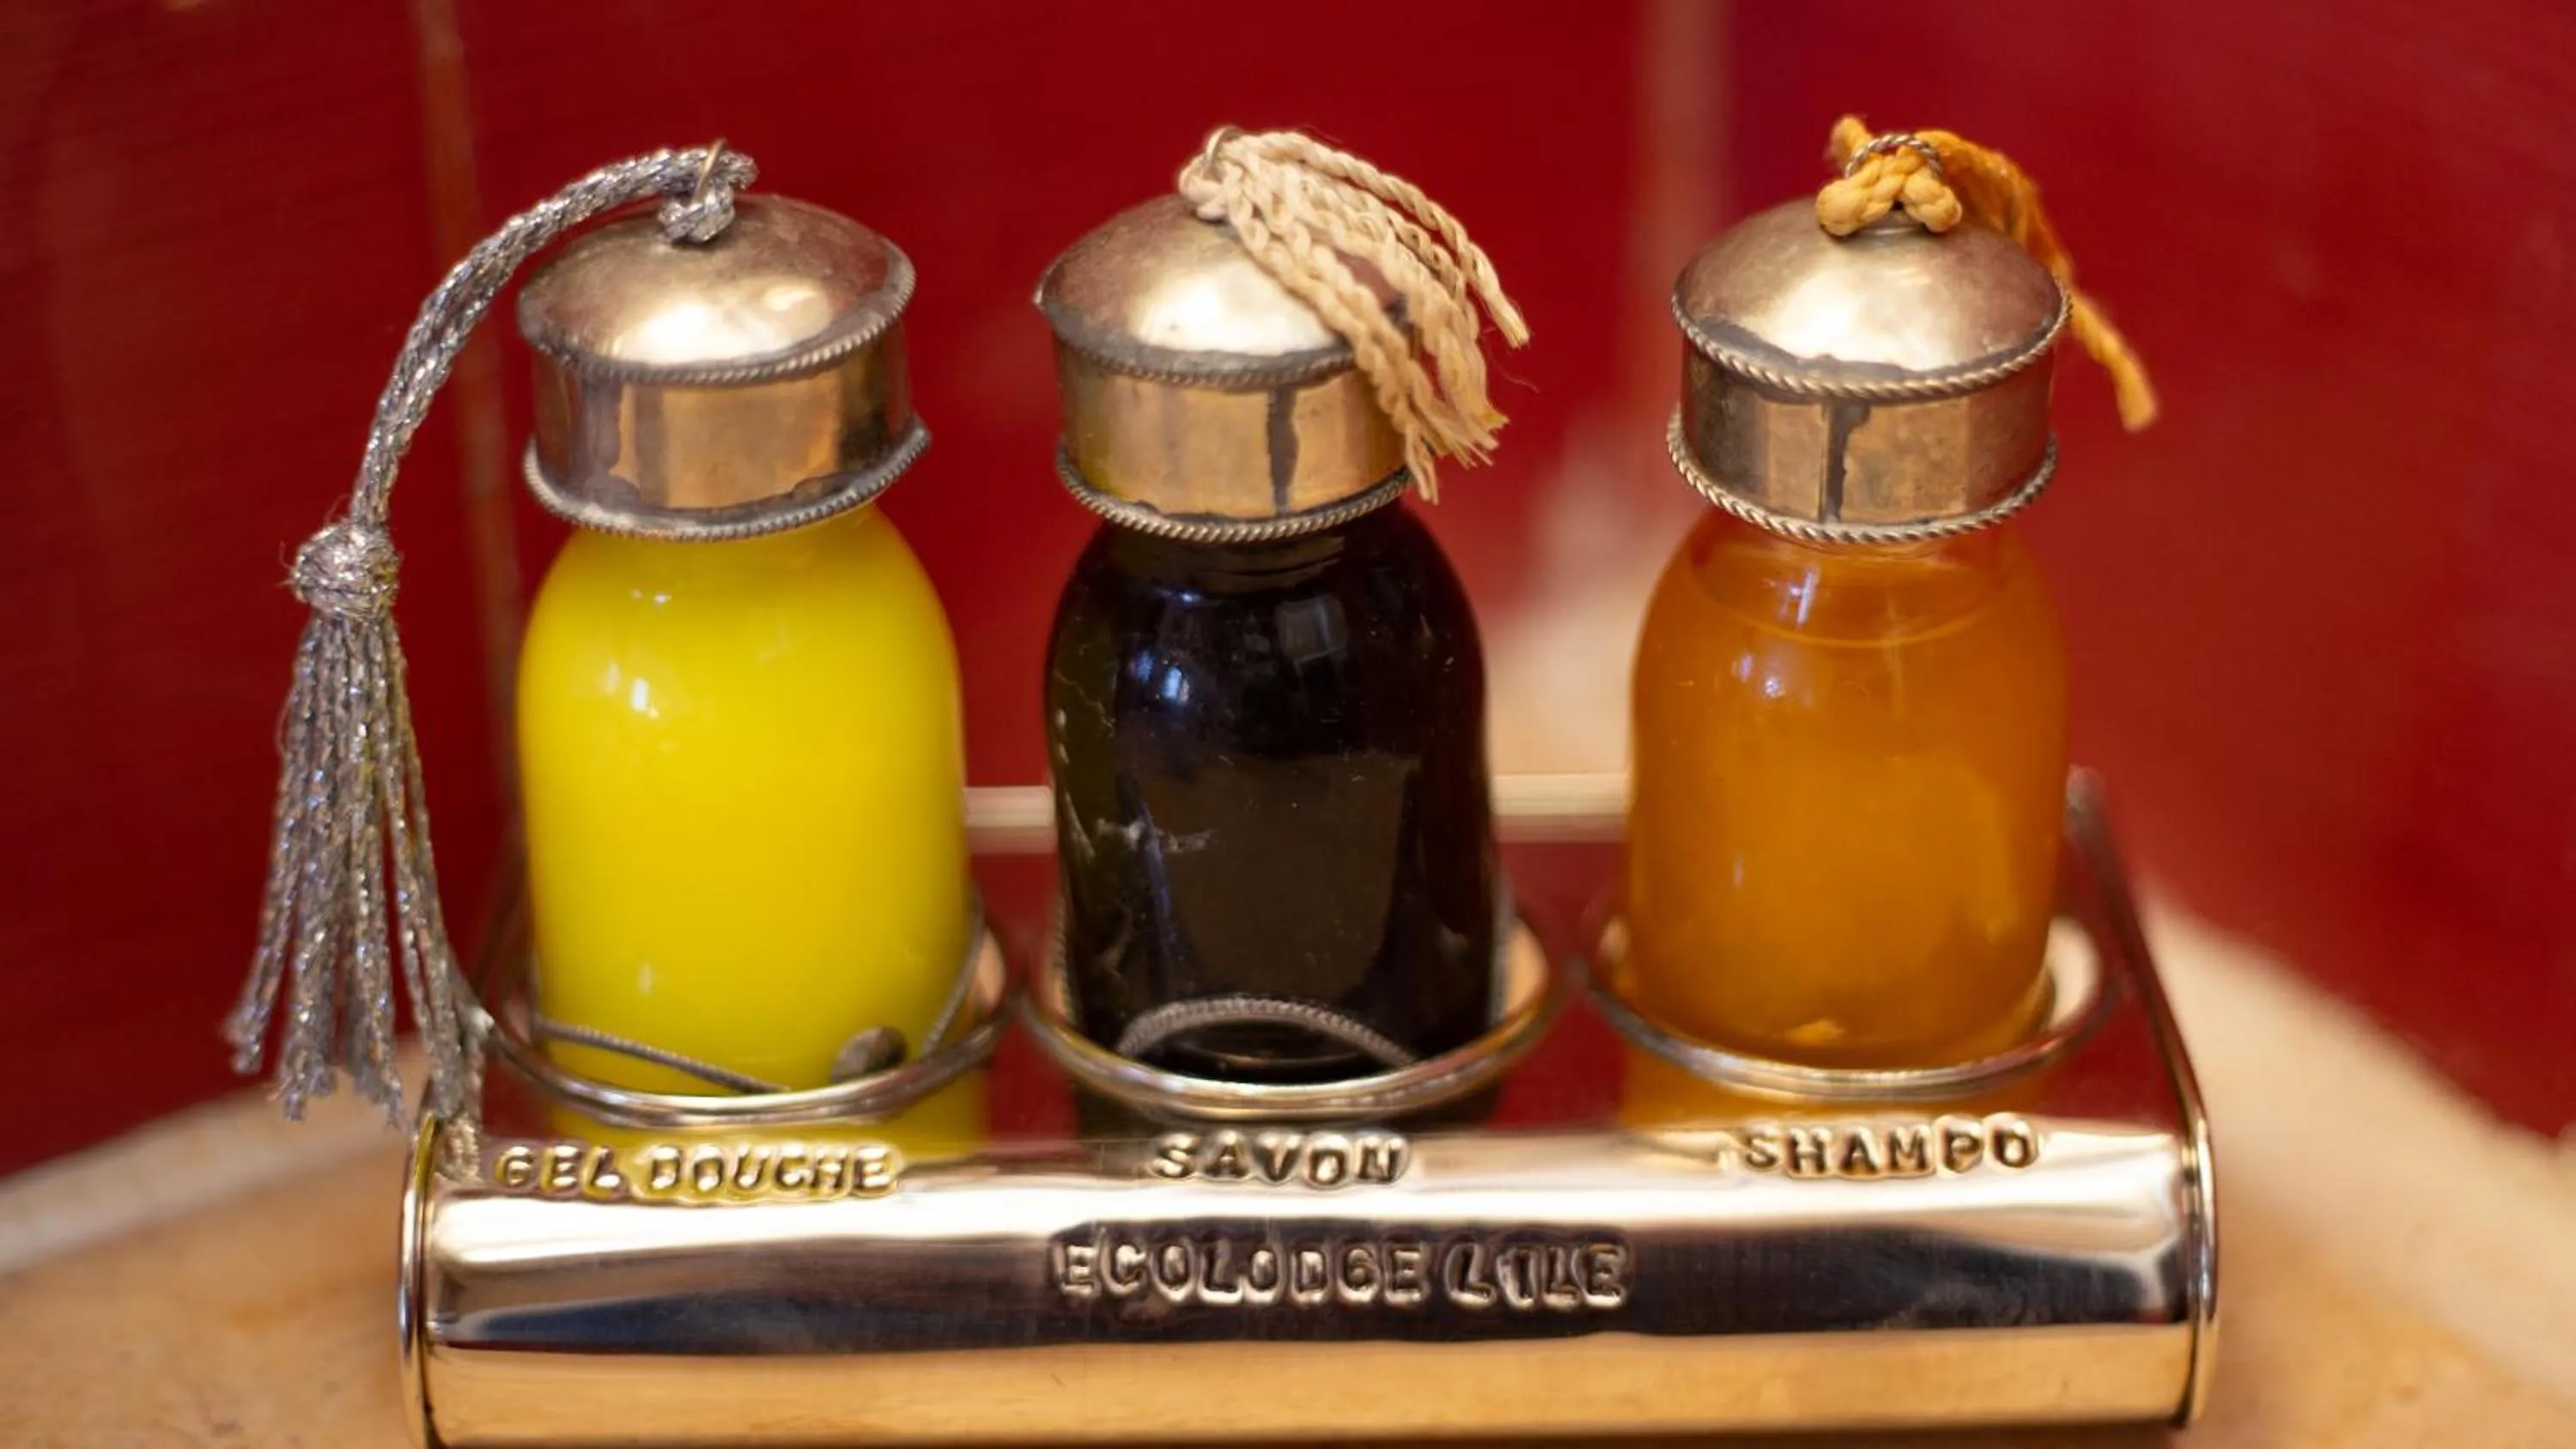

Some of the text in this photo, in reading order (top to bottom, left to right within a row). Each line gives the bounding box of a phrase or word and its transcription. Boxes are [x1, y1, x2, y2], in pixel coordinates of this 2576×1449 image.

[496, 1143, 902, 1198] GEL DOUCHE
[1151, 1131, 1408, 1188] SAVON
[1743, 1114, 2038, 1178] SHAMPO
[1056, 1243, 1425, 1307] ECOLODGE
